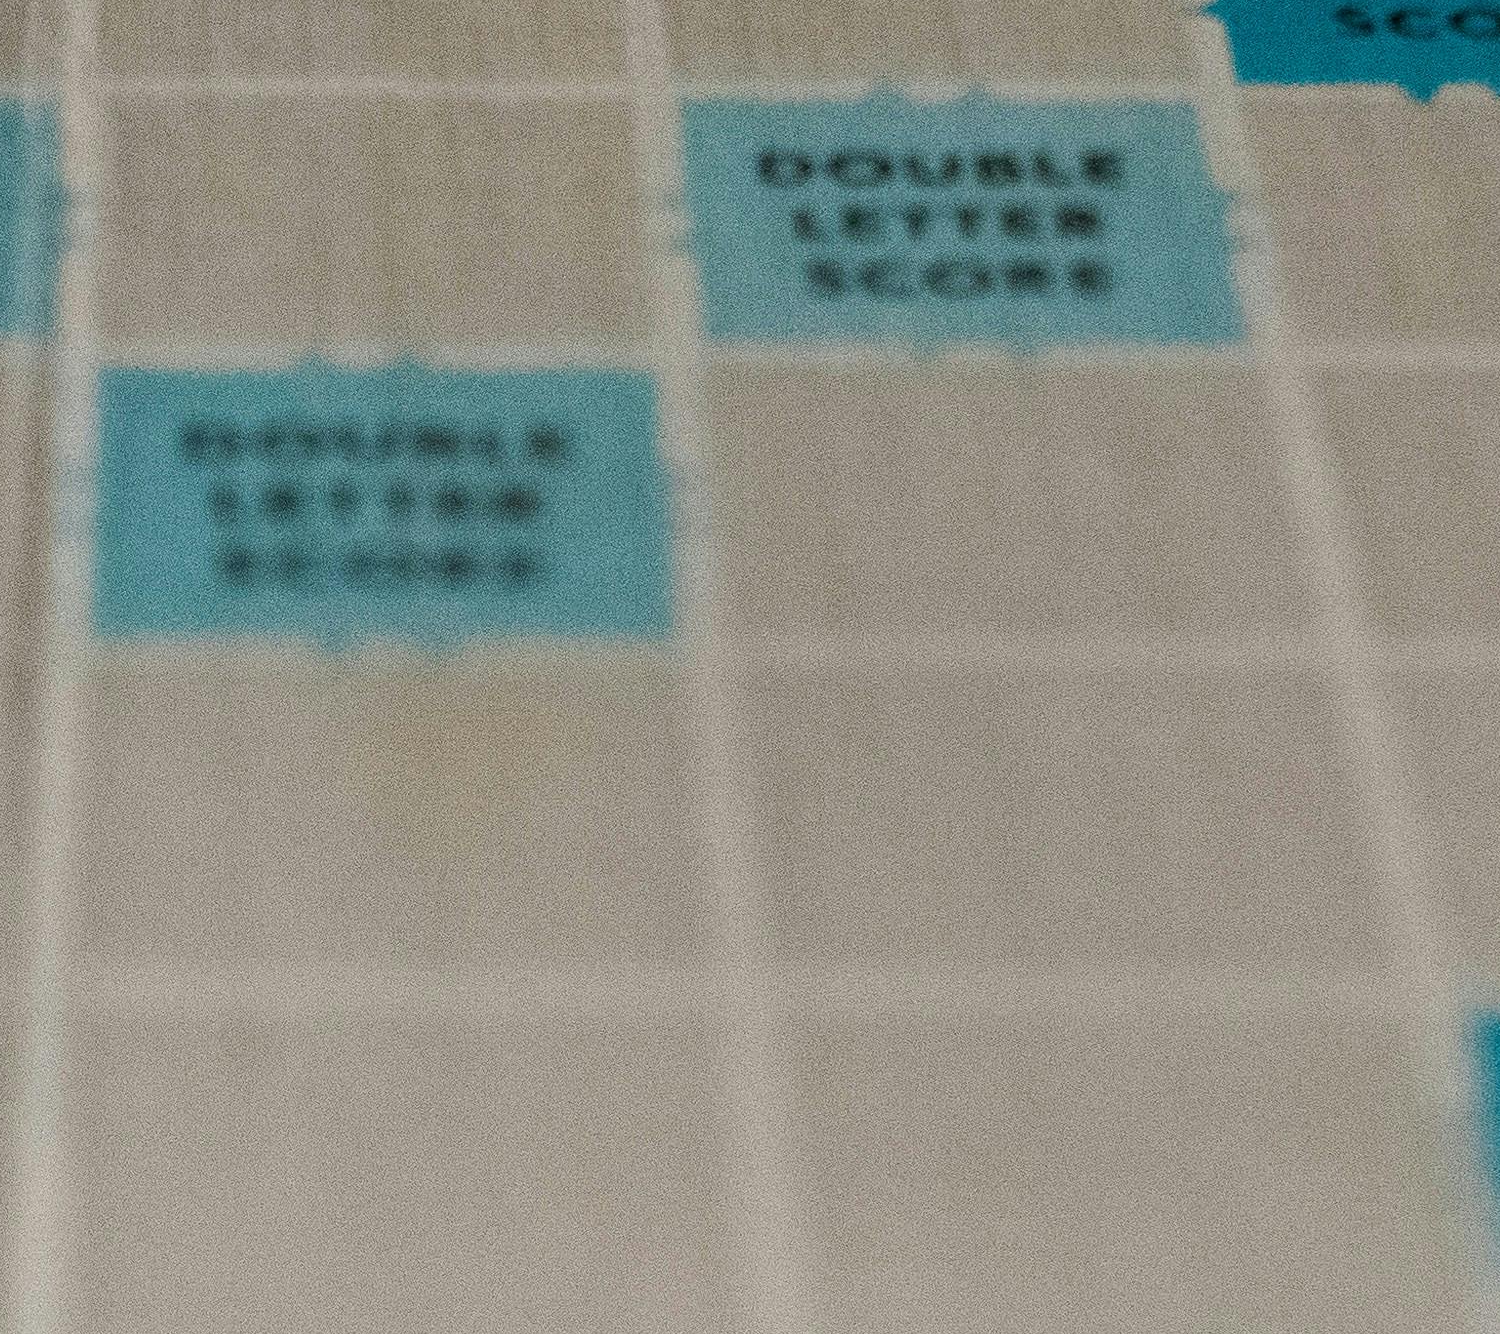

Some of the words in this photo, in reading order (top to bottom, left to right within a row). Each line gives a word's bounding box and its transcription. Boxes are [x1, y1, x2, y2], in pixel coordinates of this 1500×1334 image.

[758, 148, 1122, 189] DOUBLE
[792, 203, 1100, 241] LETTER
[805, 259, 1115, 302] SCORE
